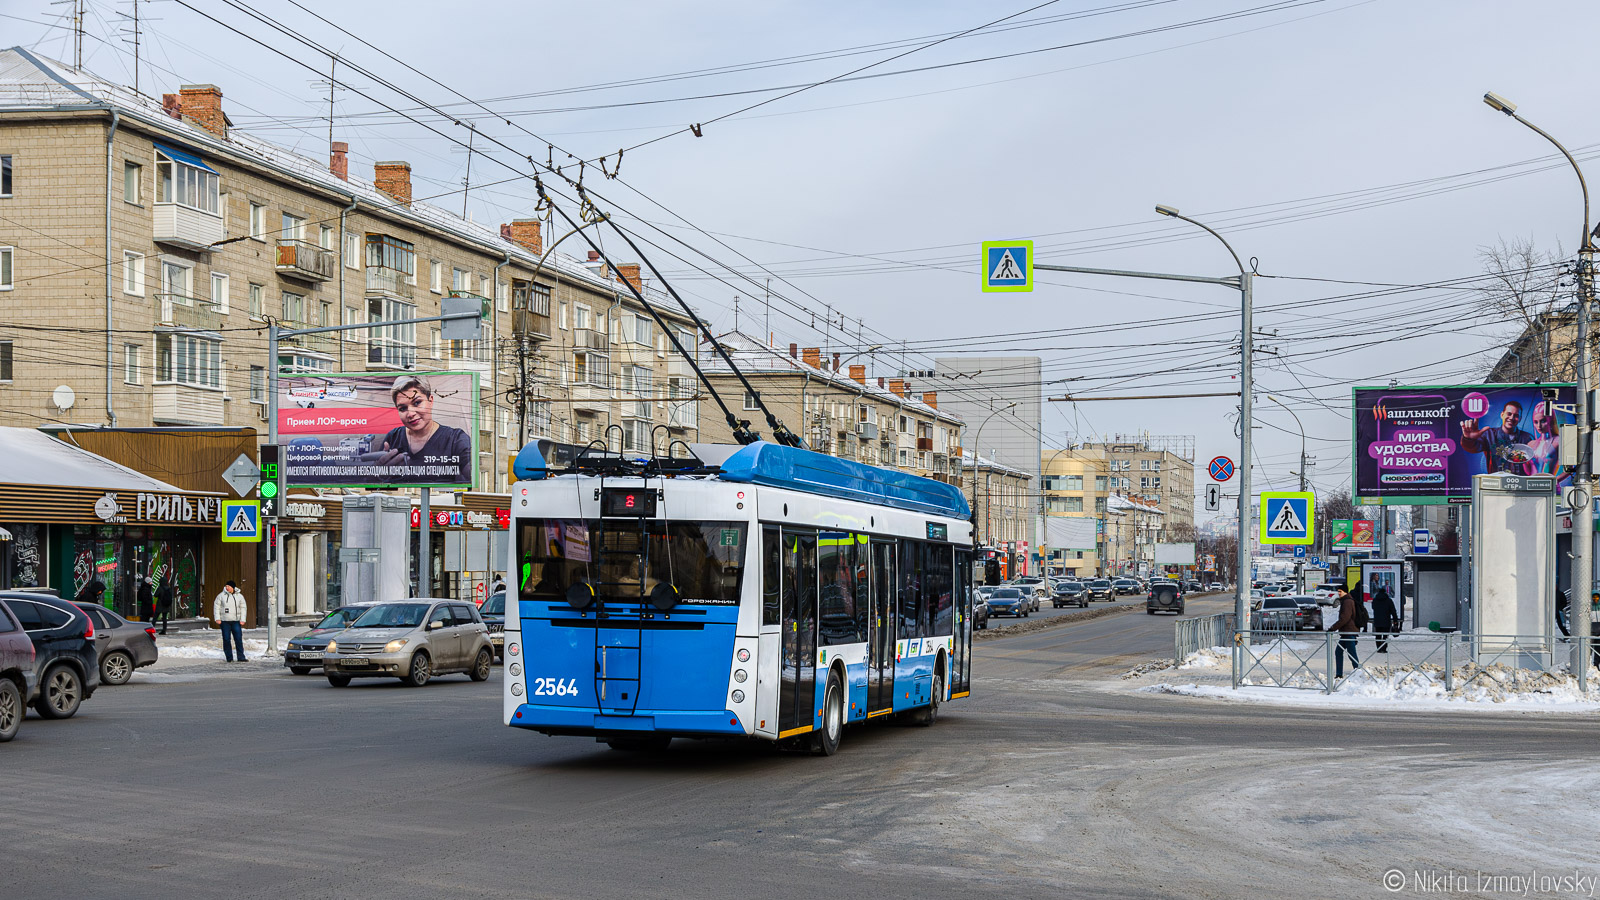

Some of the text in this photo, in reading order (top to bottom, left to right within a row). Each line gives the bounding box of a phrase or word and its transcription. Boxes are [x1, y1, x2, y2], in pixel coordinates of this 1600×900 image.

[286, 417, 368, 427] Прием ЛОР-врача
[1398, 433, 1431, 442] МИР
[301, 445, 357, 453] ЛОР-стационар
[1374, 443, 1450, 456] УДОБСТВА
[286, 454, 322, 462] Цифровой
[424, 455, 460, 464] 319-15-51
[1382, 457, 1443, 468] И ВКУСА
[260, 463, 278, 479] 49
[286, 465, 460, 477] ИМЕЮТСЯ ПРОТИВОПОКАЗАНИЯ НЕОБХОДИМА КОНСУЛЬТАЦИЯ СПЕЦИАЛИСТА
[136, 492, 193, 522] ГРИЛЬ
[534, 677, 579, 697] 2564
